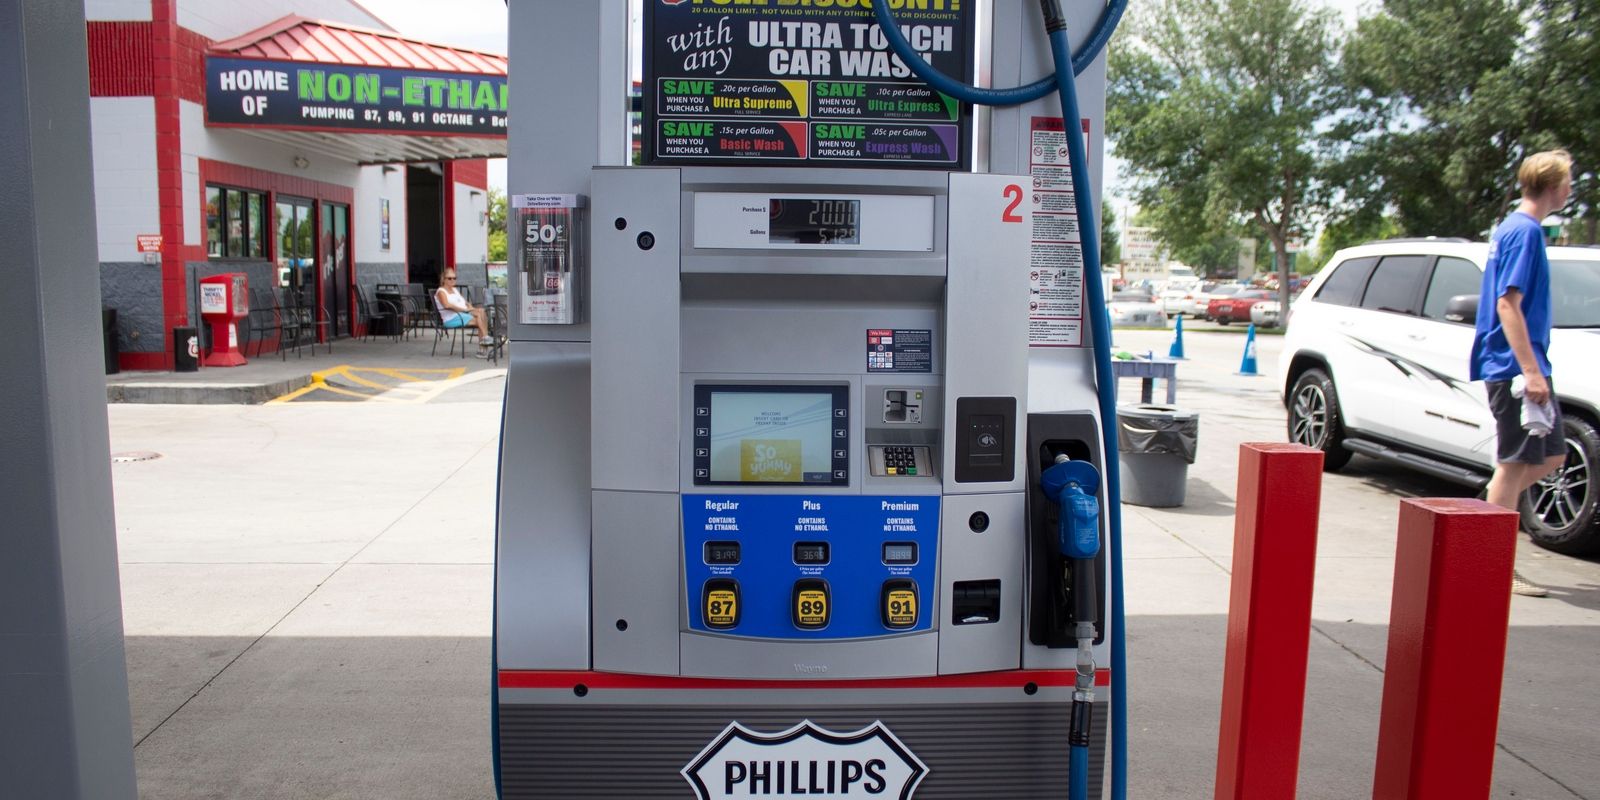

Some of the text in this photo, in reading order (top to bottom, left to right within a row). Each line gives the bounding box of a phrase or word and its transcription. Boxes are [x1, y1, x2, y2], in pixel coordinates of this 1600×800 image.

[667, 16, 952, 52] with ULTRA TOCH
[684, 47, 732, 75] any
[769, 49, 830, 76] CAR
[220, 70, 289, 90] HOME
[664, 80, 714, 94] SAVE
[752, 85, 776, 93] Gallon
[816, 82, 866, 97] SAVE
[714, 96, 792, 110] Ultra Supreme
[868, 100, 940, 112] Ultra Express
[242, 95, 268, 116] OF
[302, 106, 354, 120] PUMPING
[364, 110, 381, 123] 87,
[388, 110, 405, 124] 89,
[412, 112, 424, 123] 91
[432, 113, 473, 126] OCTANE
[664, 122, 714, 136] SAVE
[750, 127, 774, 135] Gallon
[816, 124, 866, 138] SAVE
[902, 128, 926, 136] Gallon
[720, 139, 784, 151] Basic Wash
[866, 142, 940, 154] Express Wash
[1002, 184, 1024, 222] 2
[706, 500, 739, 511] Regular
[803, 500, 821, 510] Plus
[882, 501, 919, 510] Premium
[710, 601, 733, 615] 87
[801, 601, 824, 615] 89
[890, 601, 913, 615] 91
[725, 758, 886, 794] PHILLIPS
